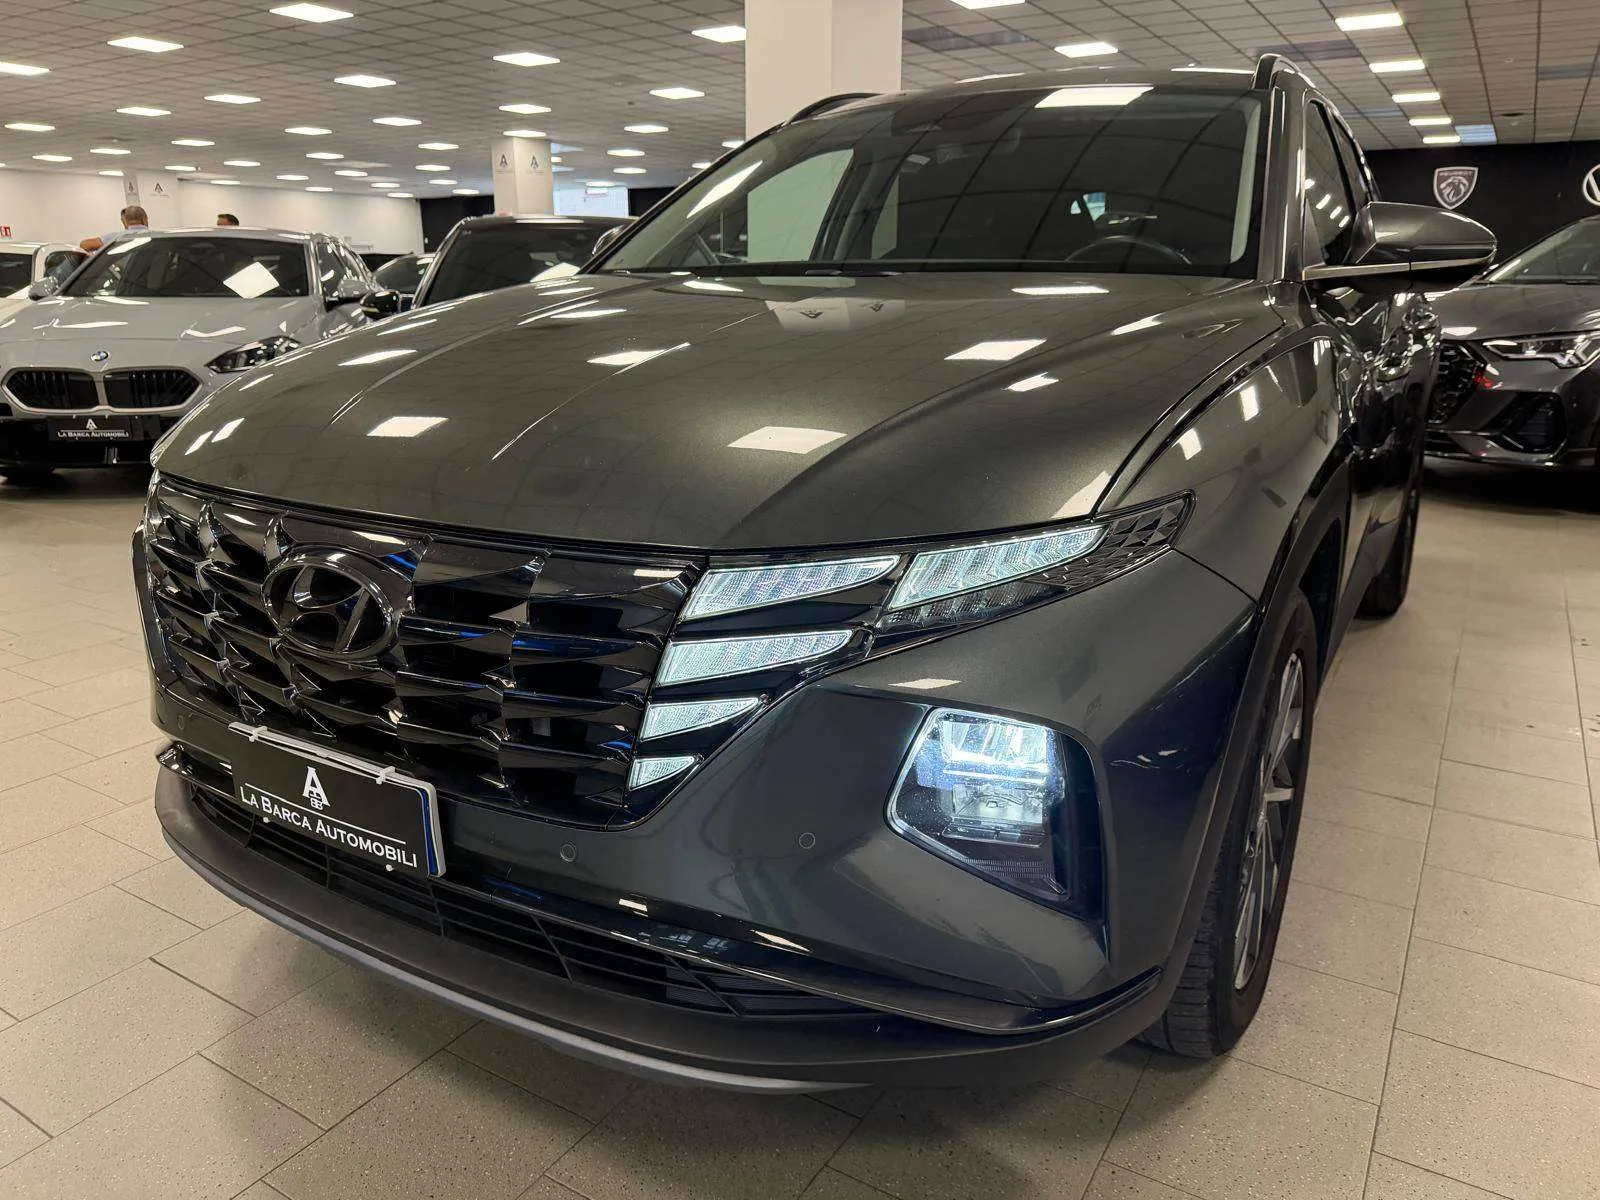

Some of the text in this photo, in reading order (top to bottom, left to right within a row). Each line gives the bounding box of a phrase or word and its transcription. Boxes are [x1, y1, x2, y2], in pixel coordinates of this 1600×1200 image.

[240, 786, 417, 868] LA BARCA AUTOMOBILI
